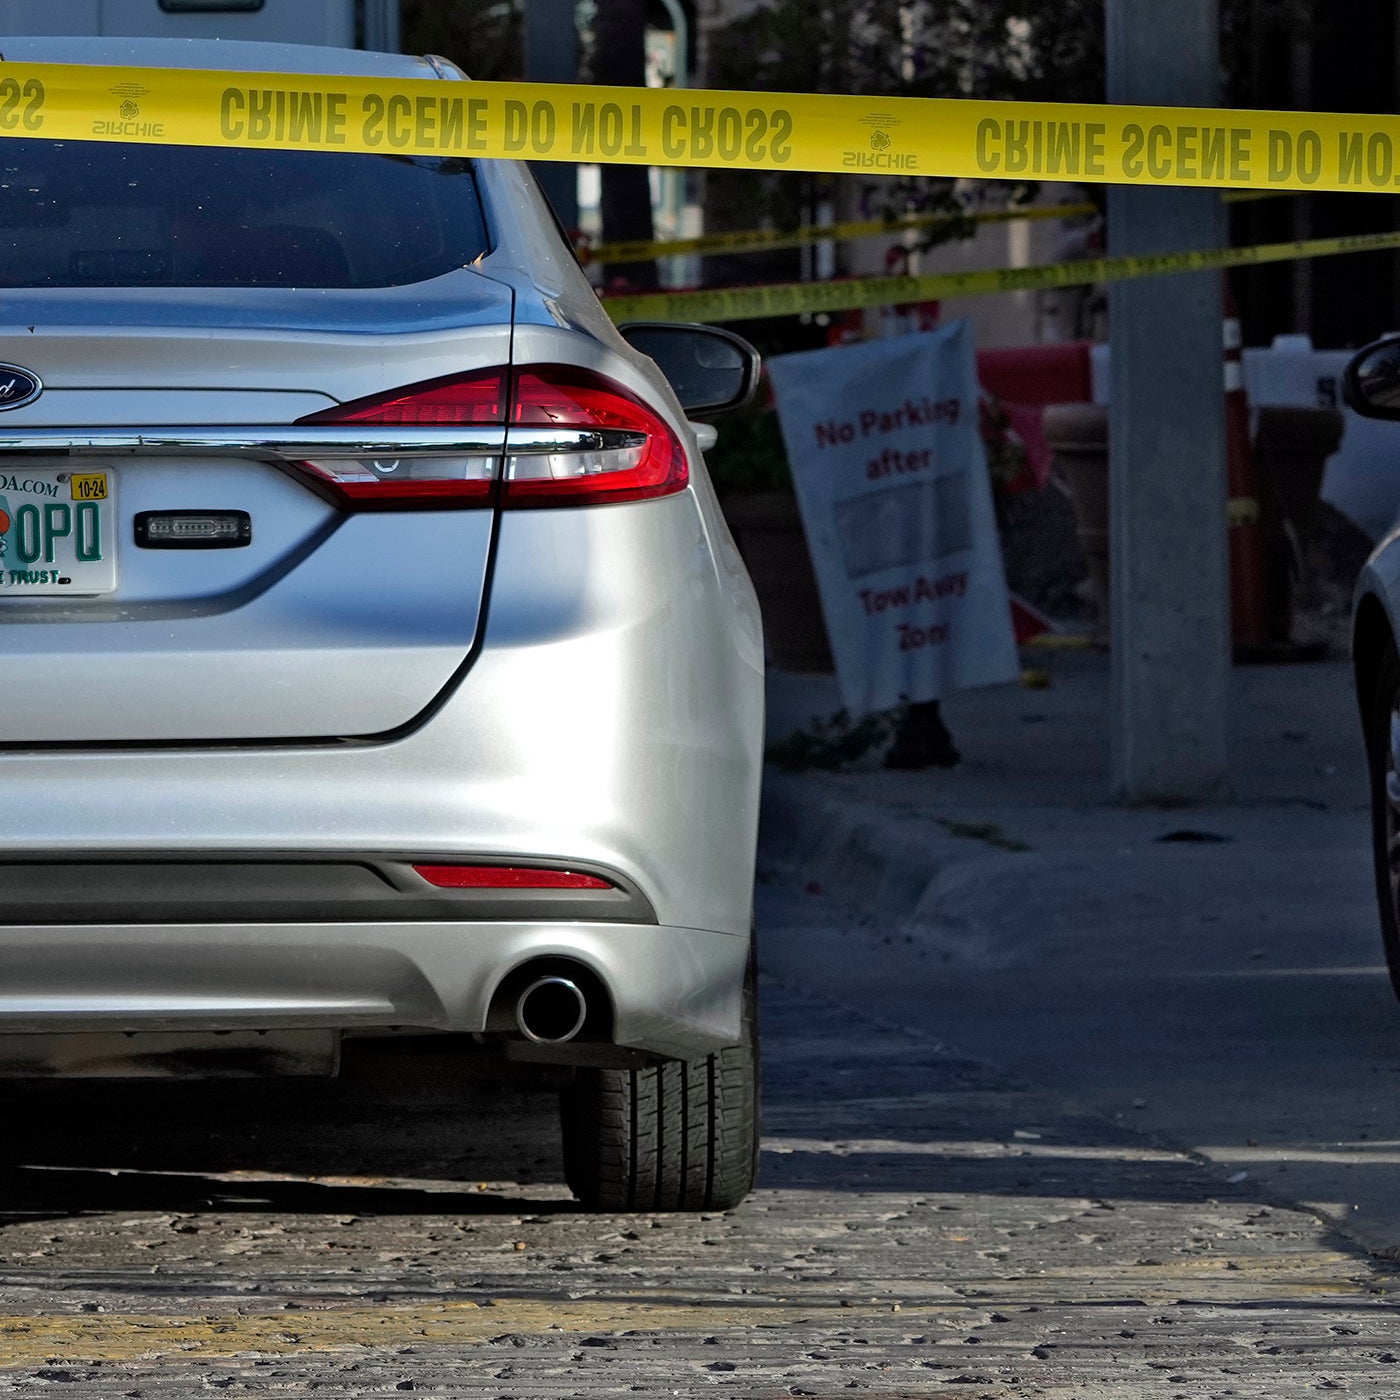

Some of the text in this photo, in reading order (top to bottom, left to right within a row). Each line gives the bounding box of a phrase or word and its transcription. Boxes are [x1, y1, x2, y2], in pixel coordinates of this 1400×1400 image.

[815, 397, 961, 448] No Parking
[865, 448, 931, 481] after
[78, 480, 105, 498] 10-24
[9, 569, 60, 585] TRUST
